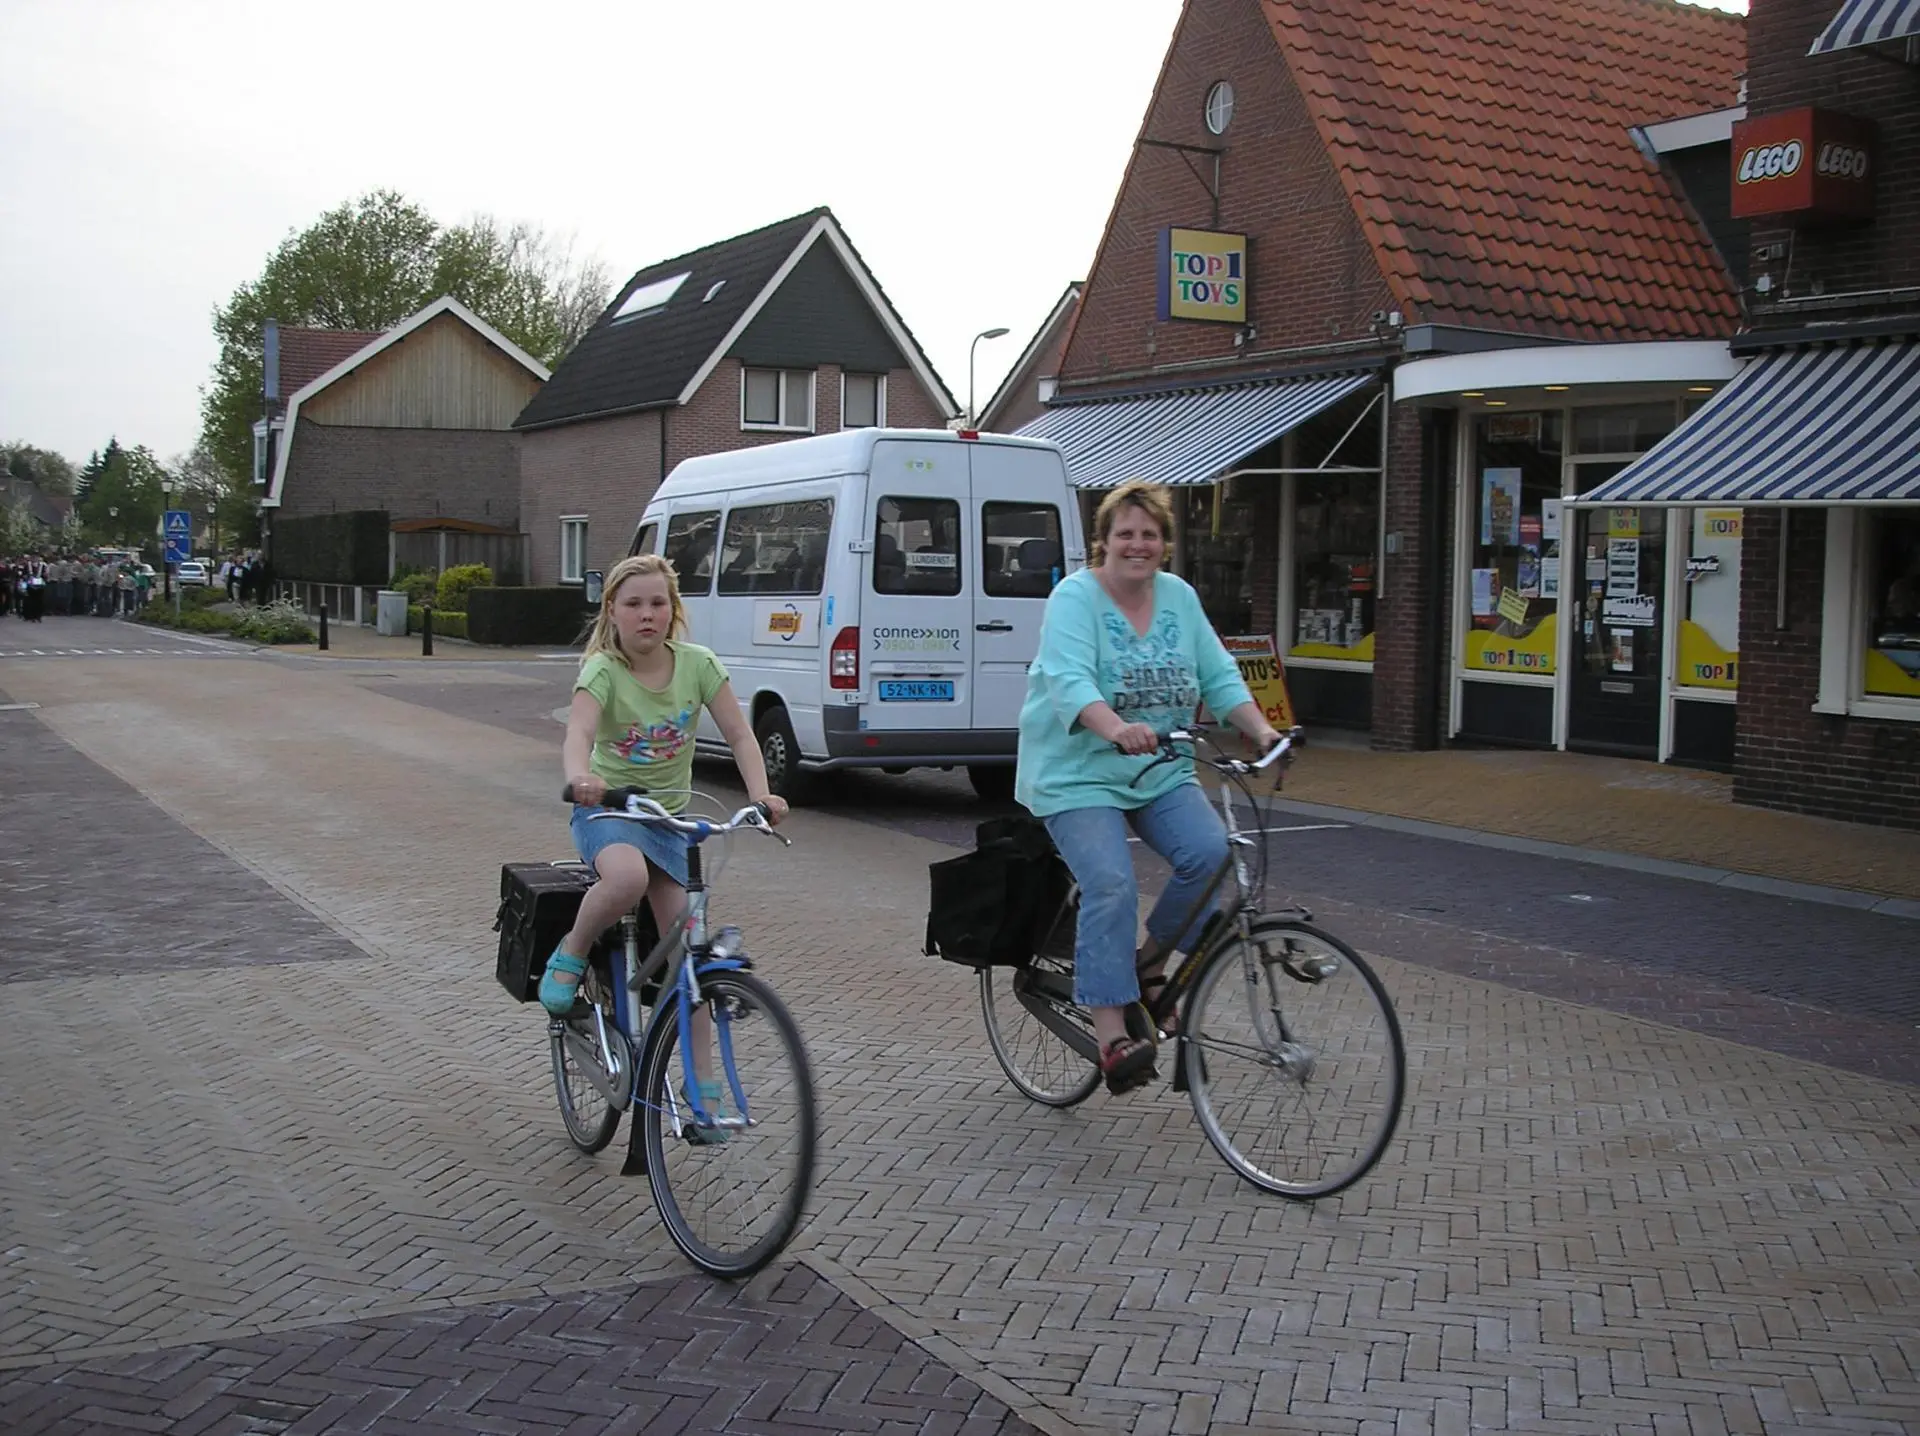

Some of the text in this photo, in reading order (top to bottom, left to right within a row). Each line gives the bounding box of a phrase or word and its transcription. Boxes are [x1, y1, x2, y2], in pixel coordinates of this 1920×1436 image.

[1737, 141, 1803, 184] LEGO
[1817, 142, 1867, 179] LEGO
[1174, 252, 1242, 278] TOP 1
[1177, 280, 1239, 305] TOYS
[1710, 520, 1738, 533] TOP
[1238, 658, 1280, 681] OTO'S
[1483, 649, 1548, 667] TOP 1 TOYS
[1695, 662, 1734, 680] TOP 1
[887, 684, 947, 696] 52-NK-RN
